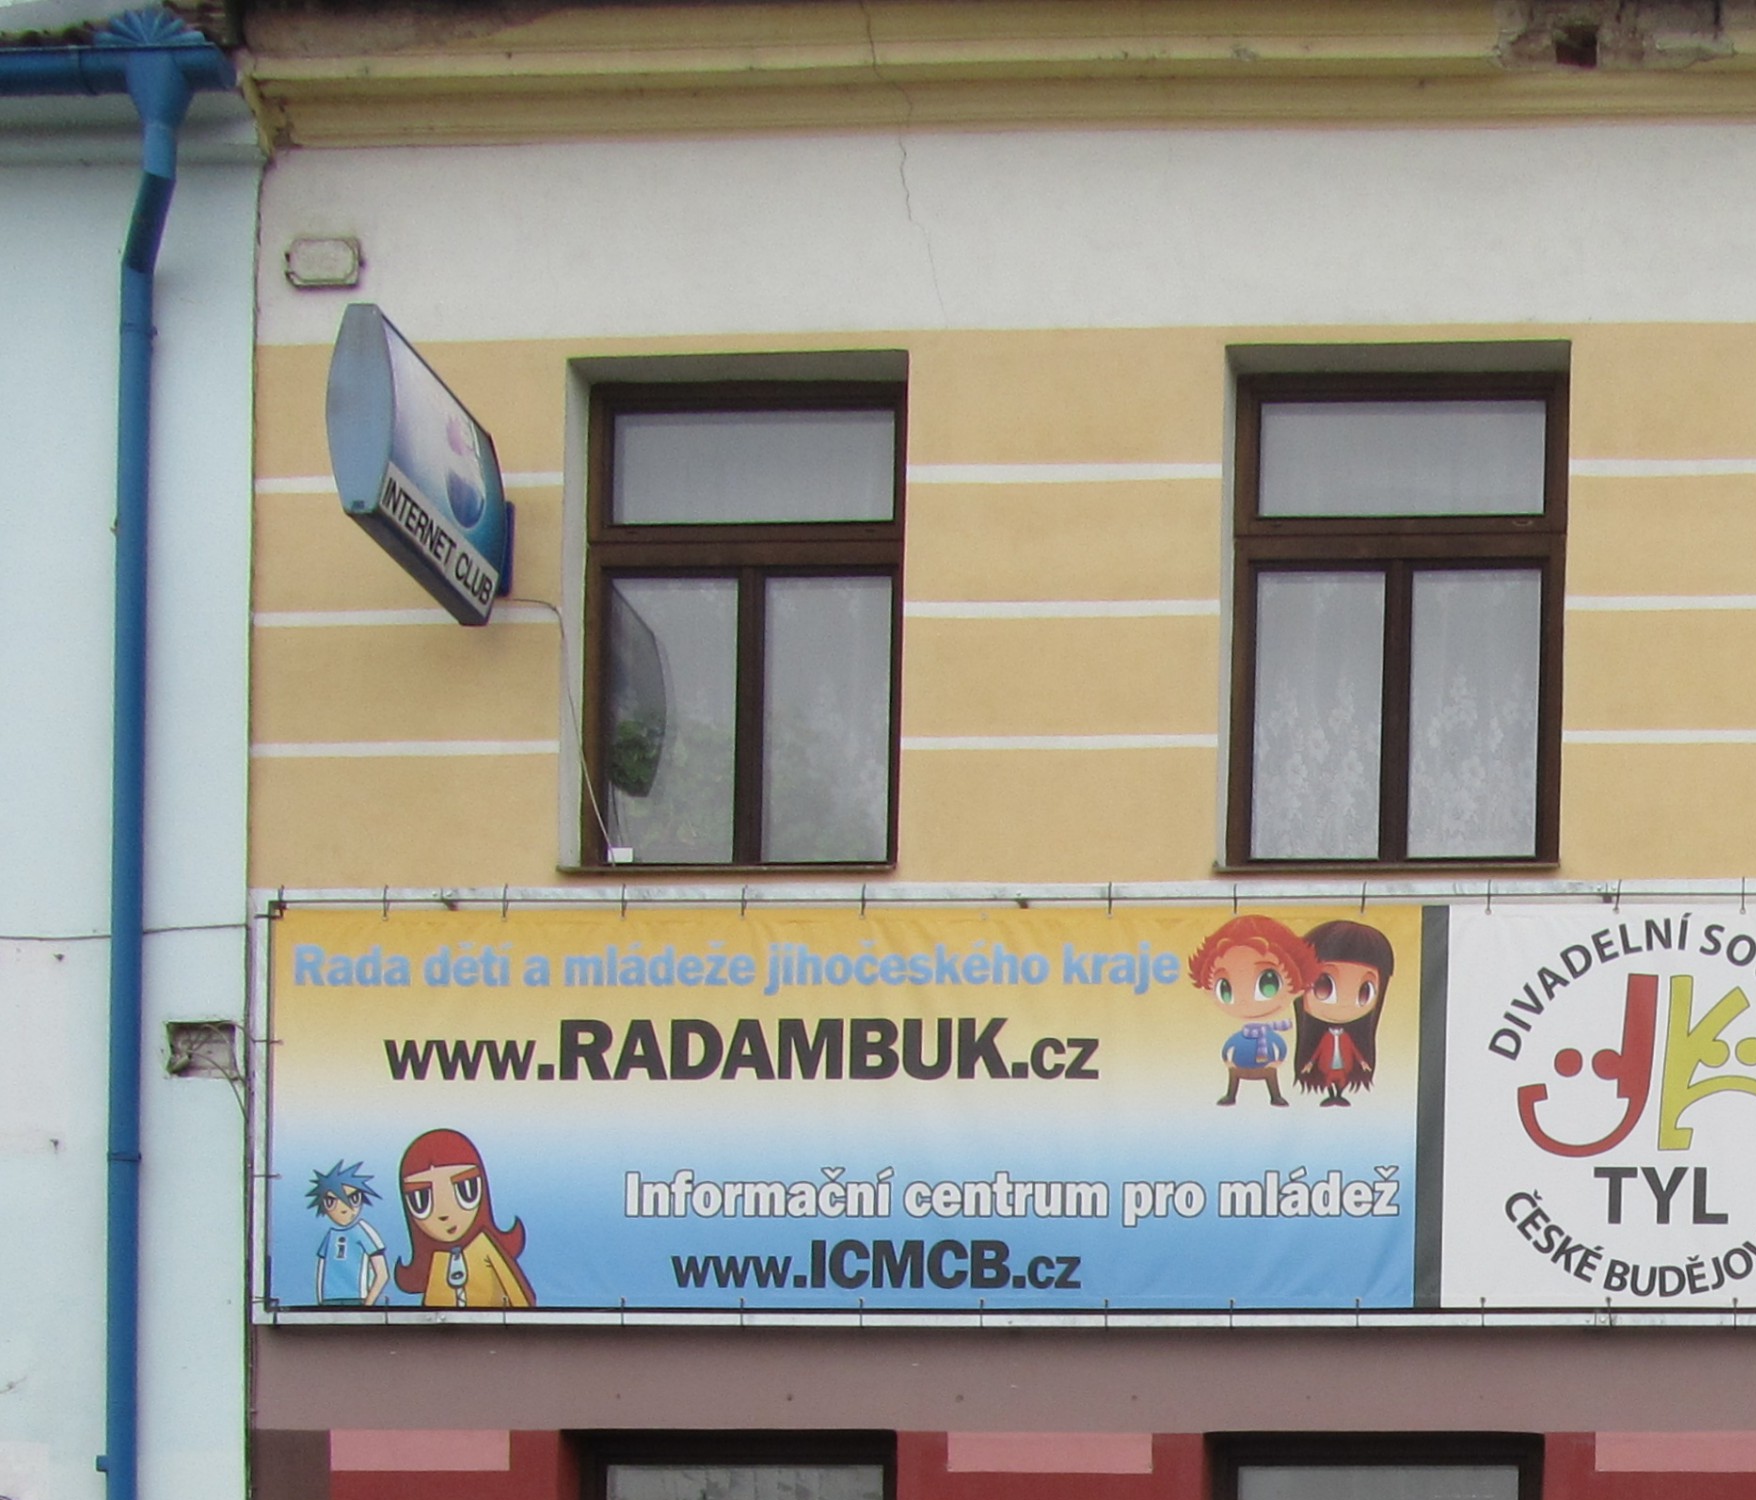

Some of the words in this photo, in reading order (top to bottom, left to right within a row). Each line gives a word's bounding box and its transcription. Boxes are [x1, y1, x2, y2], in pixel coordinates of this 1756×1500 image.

[382, 477, 457, 566] INTERNET
[455, 552, 493, 605] CLUB
[292, 943, 411, 987] Rada
[423, 940, 513, 987] dětí
[522, 954, 551, 987] a
[564, 940, 756, 987] mládeže
[764, 940, 1050, 996] jihočeského
[1062, 940, 1181, 996] kraje
[1488, 912, 1692, 1061] DIVADELNÍ
[384, 1017, 1100, 1081] www.RADAMBUK.cz
[624, 1166, 894, 1219] Informační
[904, 1170, 1109, 1218] centrum
[1122, 1178, 1206, 1228] pro
[1218, 1165, 1400, 1218] mládež
[1593, 1166, 1730, 1225] TYL
[672, 1239, 1081, 1290] www.ICMCB.cz
[1504, 1189, 1604, 1283] ČESKÉ
